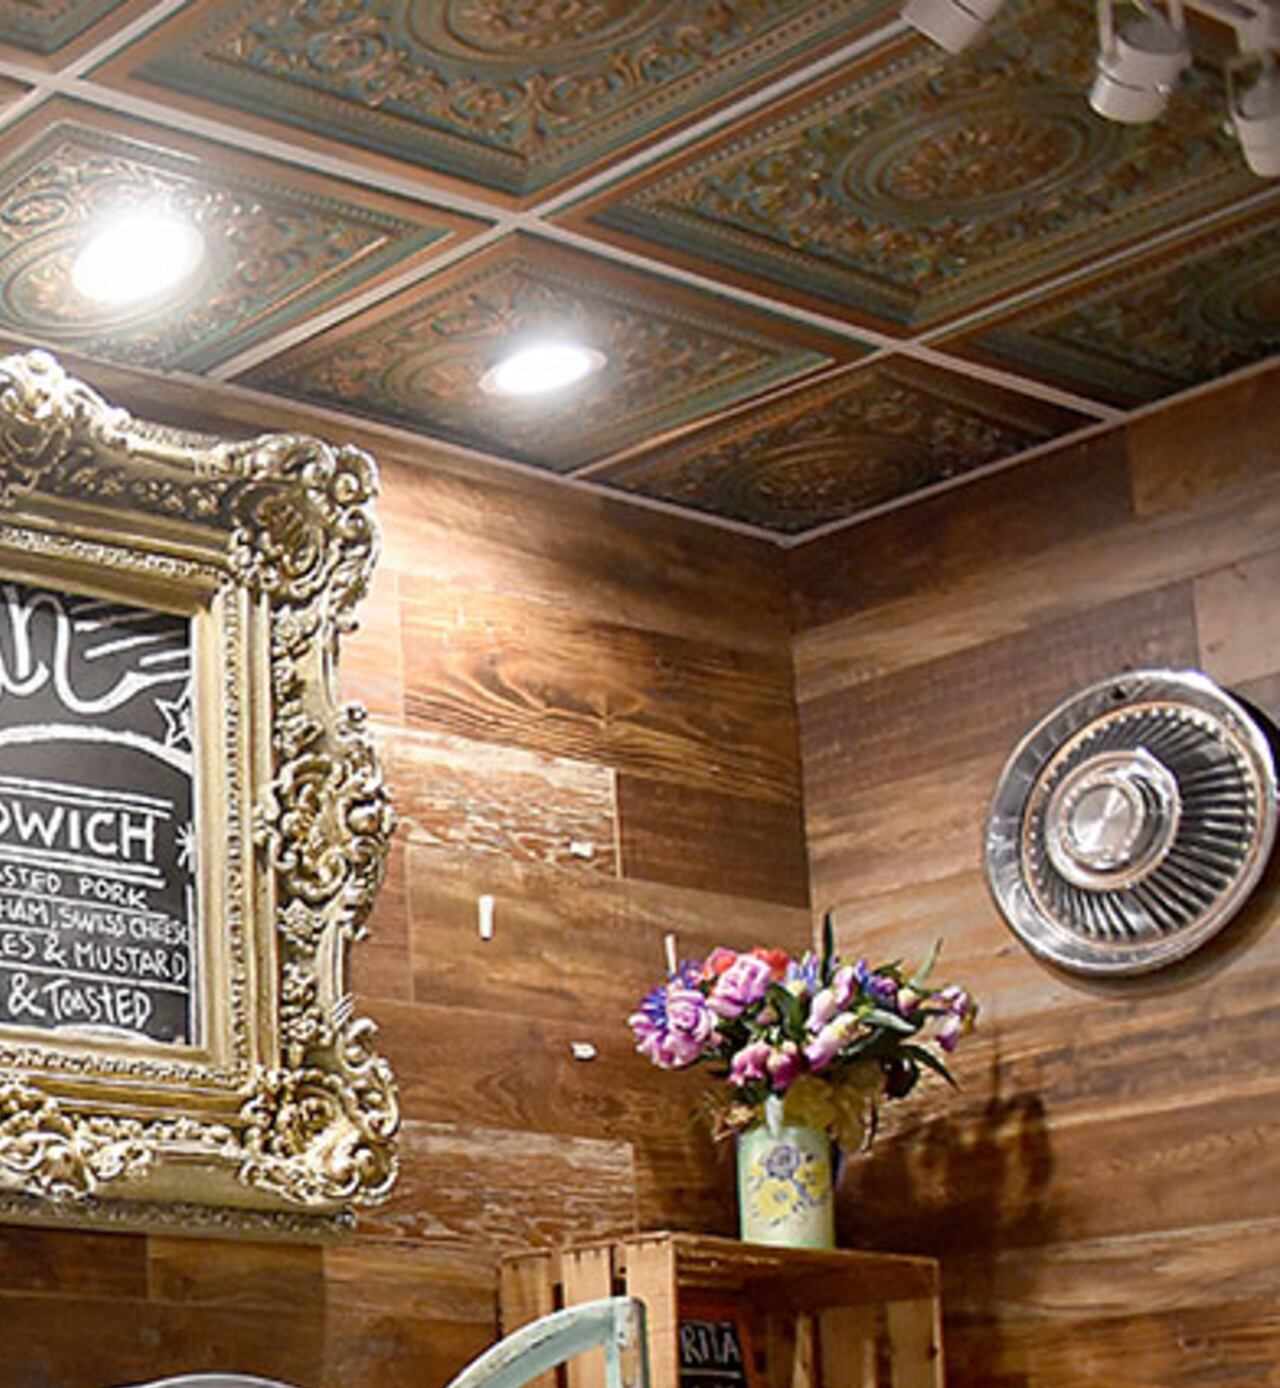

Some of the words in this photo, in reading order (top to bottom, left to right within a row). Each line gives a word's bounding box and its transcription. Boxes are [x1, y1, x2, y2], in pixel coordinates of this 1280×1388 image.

[79, 875, 148, 910] PORK
[58, 907, 126, 937] SWISS
[44, 932, 68, 968] &
[74, 942, 187, 982] MUSTARD
[8, 971, 46, 1017] &
